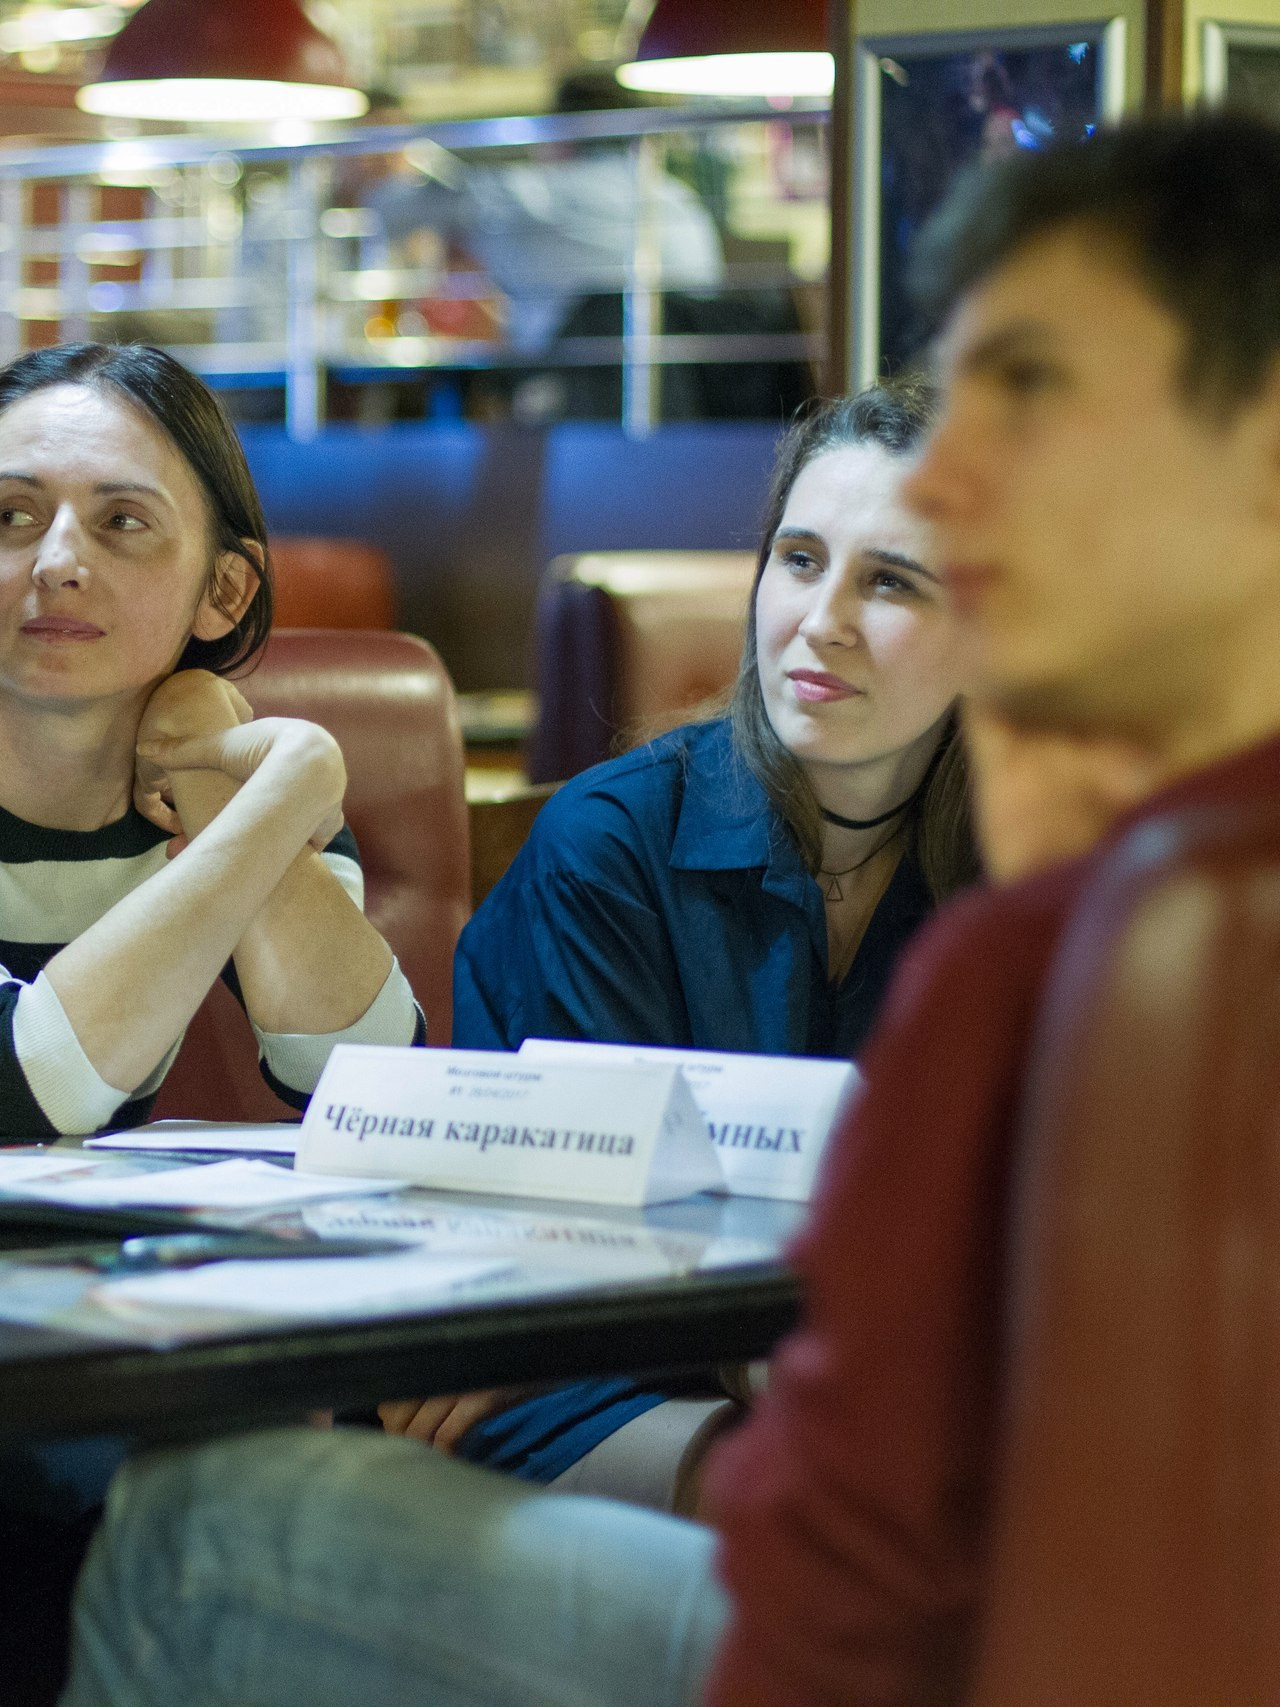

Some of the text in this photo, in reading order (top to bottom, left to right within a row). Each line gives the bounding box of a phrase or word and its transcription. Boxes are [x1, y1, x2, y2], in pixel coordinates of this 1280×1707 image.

[325, 1102, 636, 1156] Чёрная каракатица
[703, 1112, 805, 1153] мных
